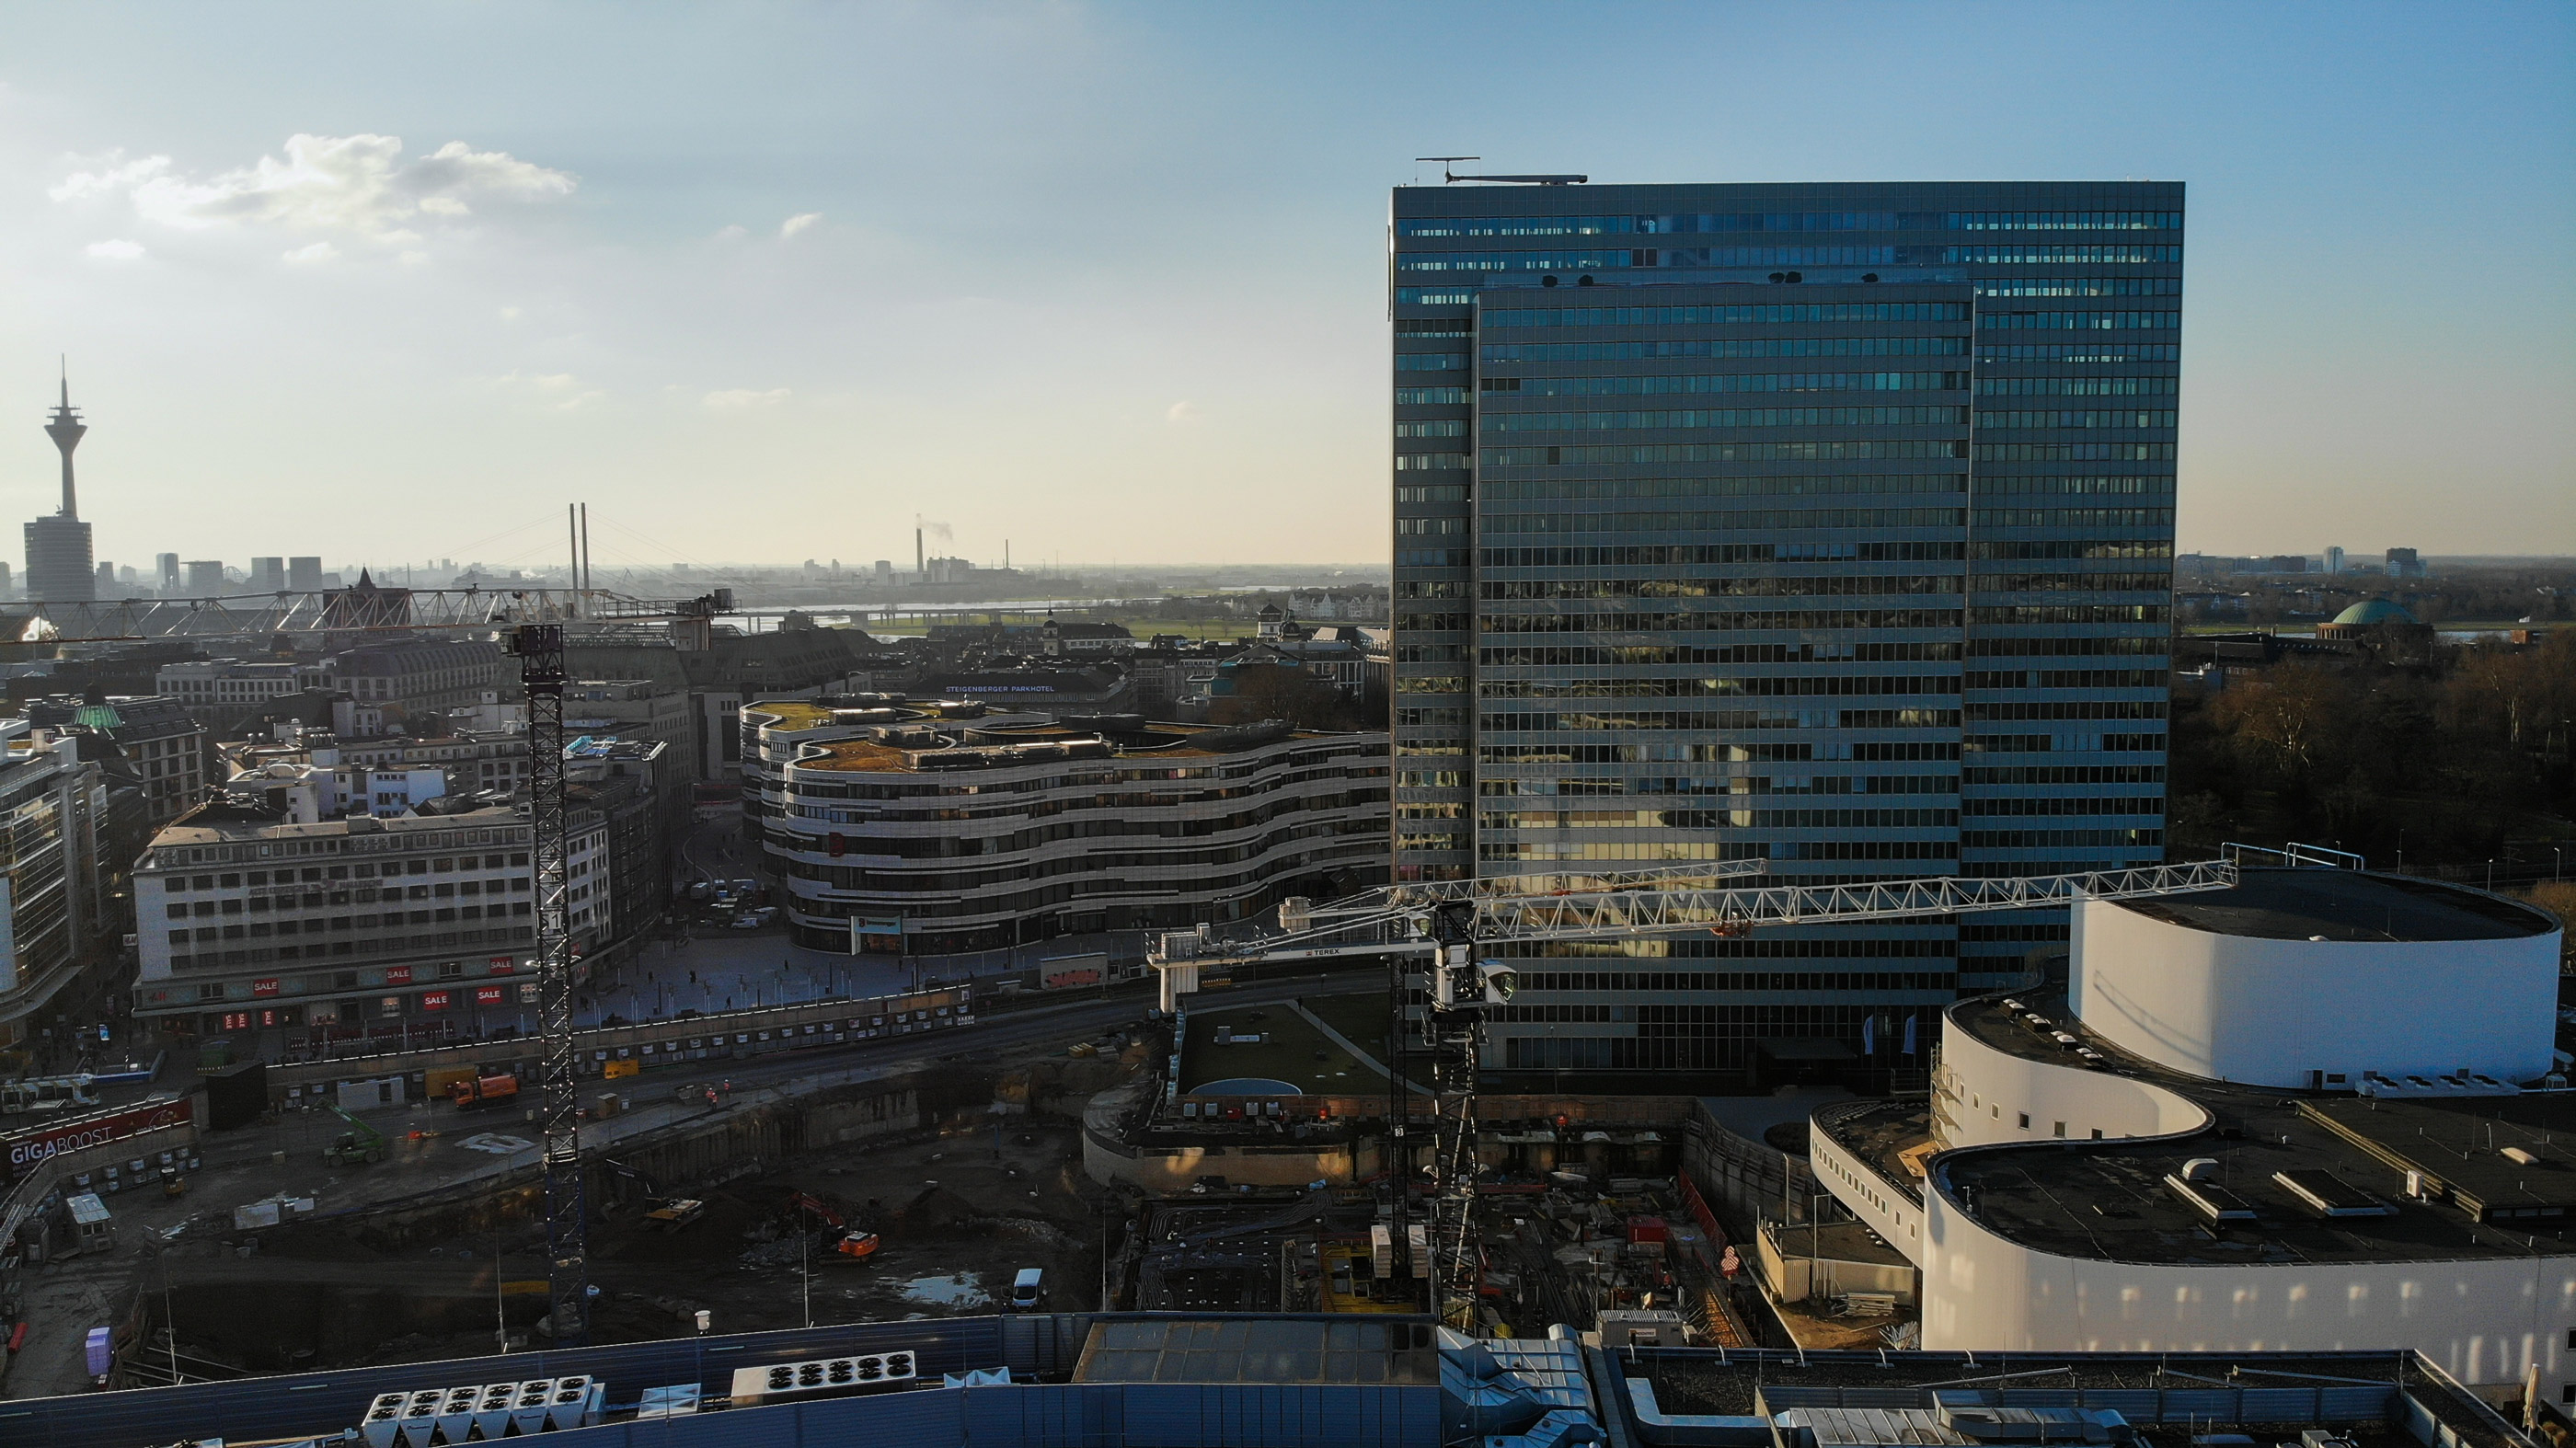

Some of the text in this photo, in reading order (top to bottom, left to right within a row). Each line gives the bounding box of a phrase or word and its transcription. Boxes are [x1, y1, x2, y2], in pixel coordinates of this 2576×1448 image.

[551, 914, 559, 928] 1
[489, 960, 512, 969] SALE
[386, 969, 409, 978] SALE
[254, 981, 278, 992] SALE
[424, 994, 448, 1005] SALE
[477, 990, 500, 999] SALE
[10, 1125, 112, 1165] GIGABOOST
